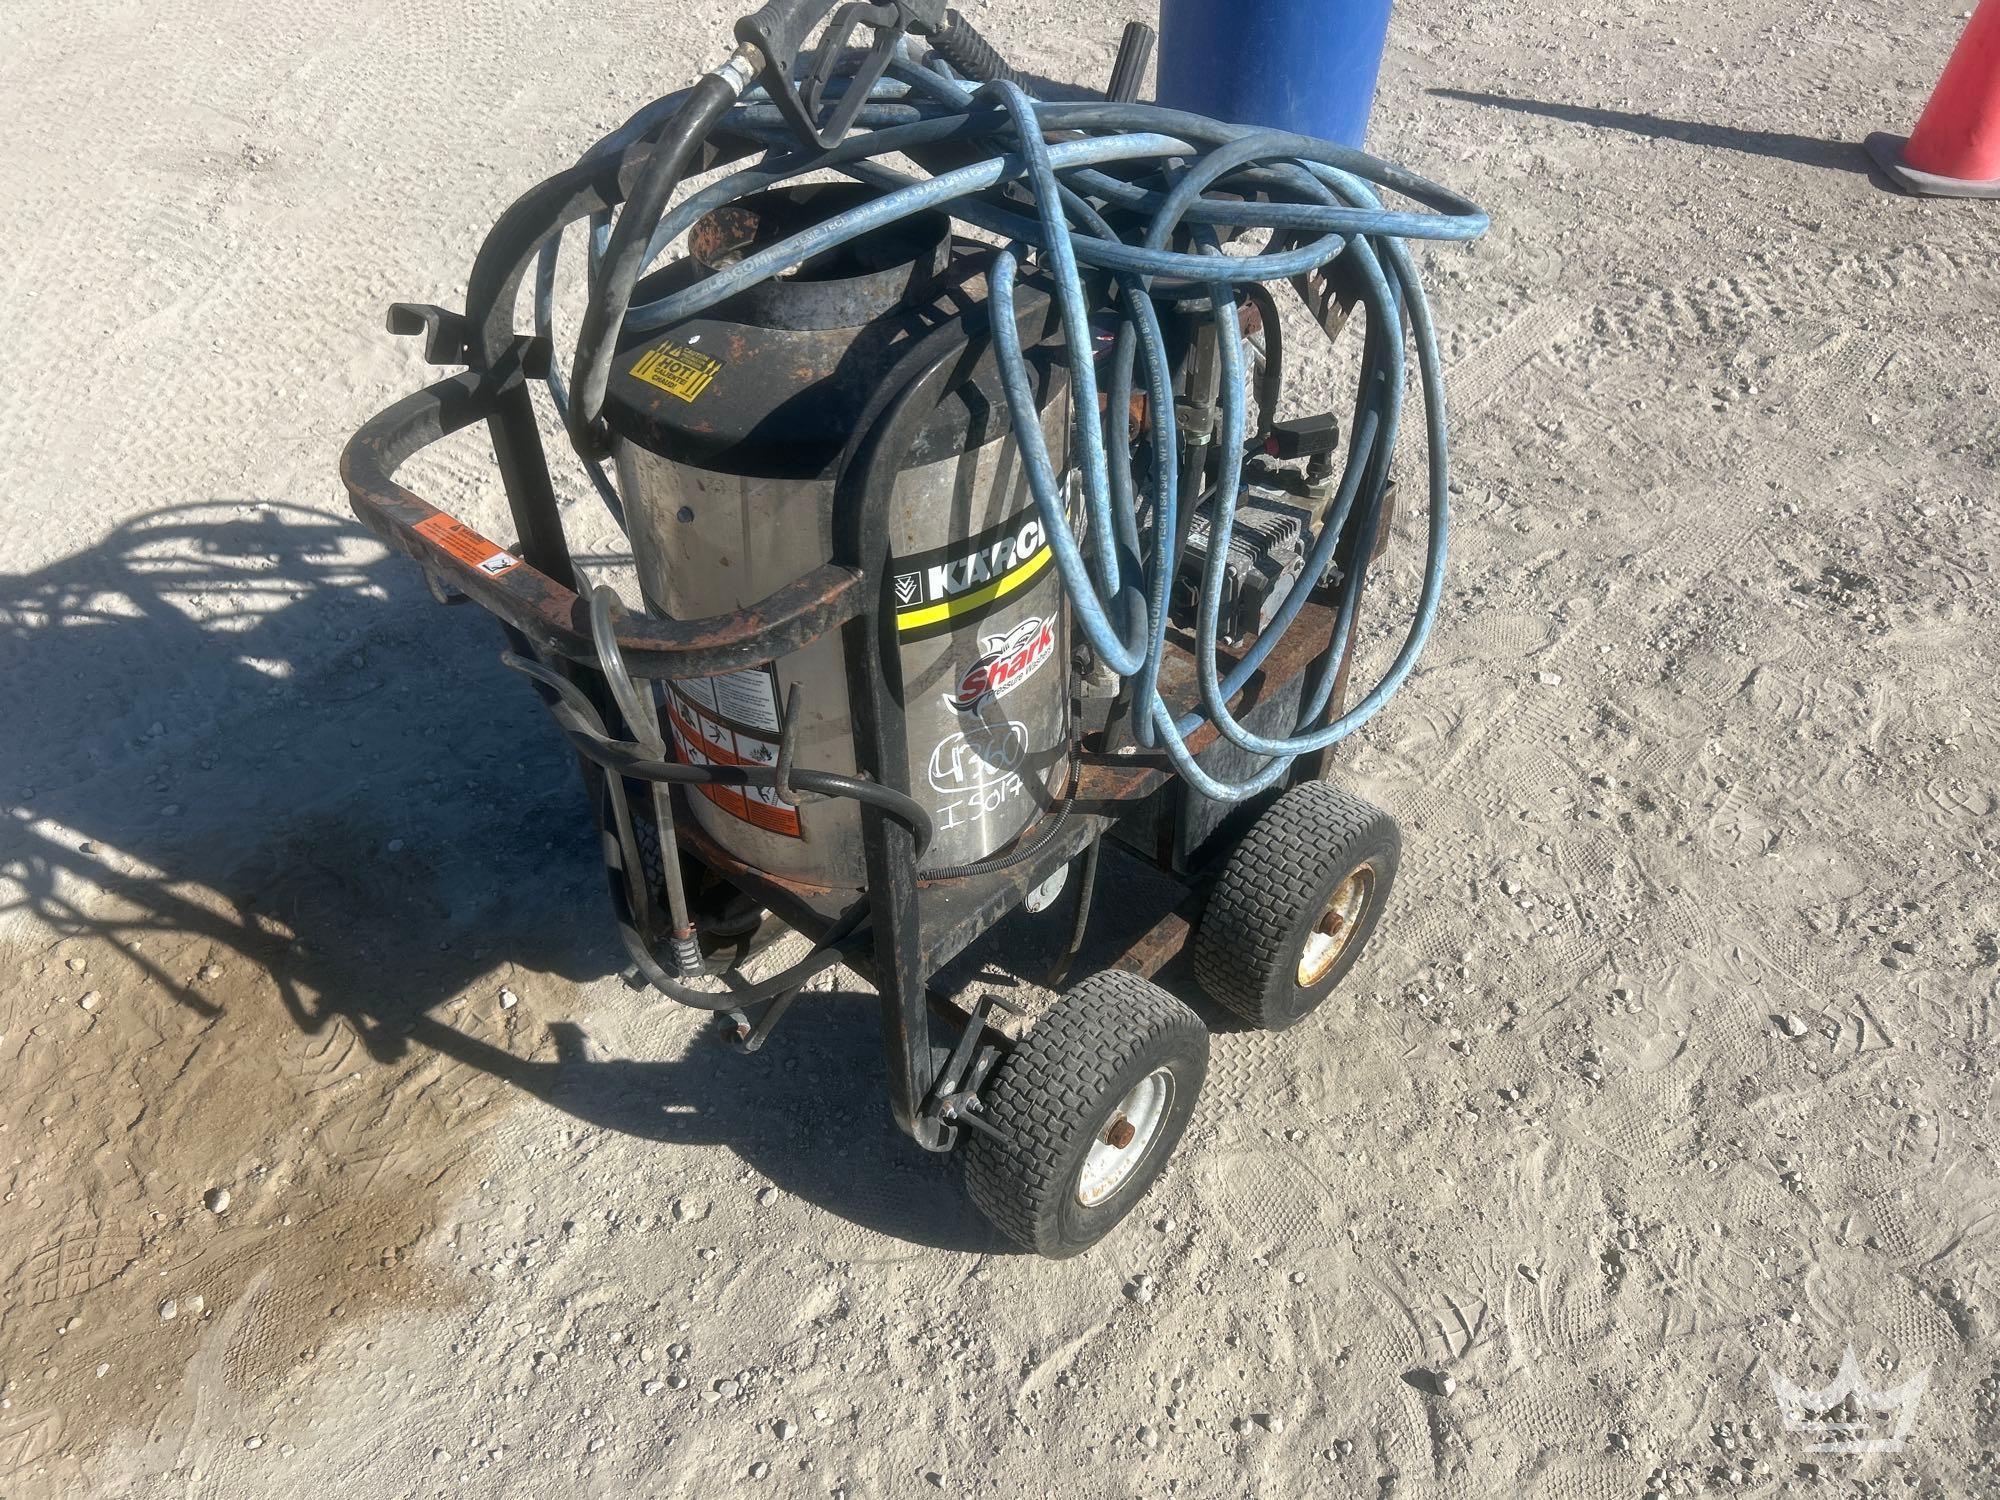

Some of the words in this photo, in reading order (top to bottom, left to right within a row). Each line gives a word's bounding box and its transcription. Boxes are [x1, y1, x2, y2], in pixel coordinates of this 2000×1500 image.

[1138, 316, 1151, 333] 853
[657, 356, 697, 380] HOT!
[651, 375, 677, 390] CHAUD!
[1156, 405, 1166, 427] MPa
[1159, 515, 1167, 540] TECH
[957, 622, 1052, 704] Shark
[988, 671, 1024, 697] Pressure
[1025, 646, 1052, 675] Washers
